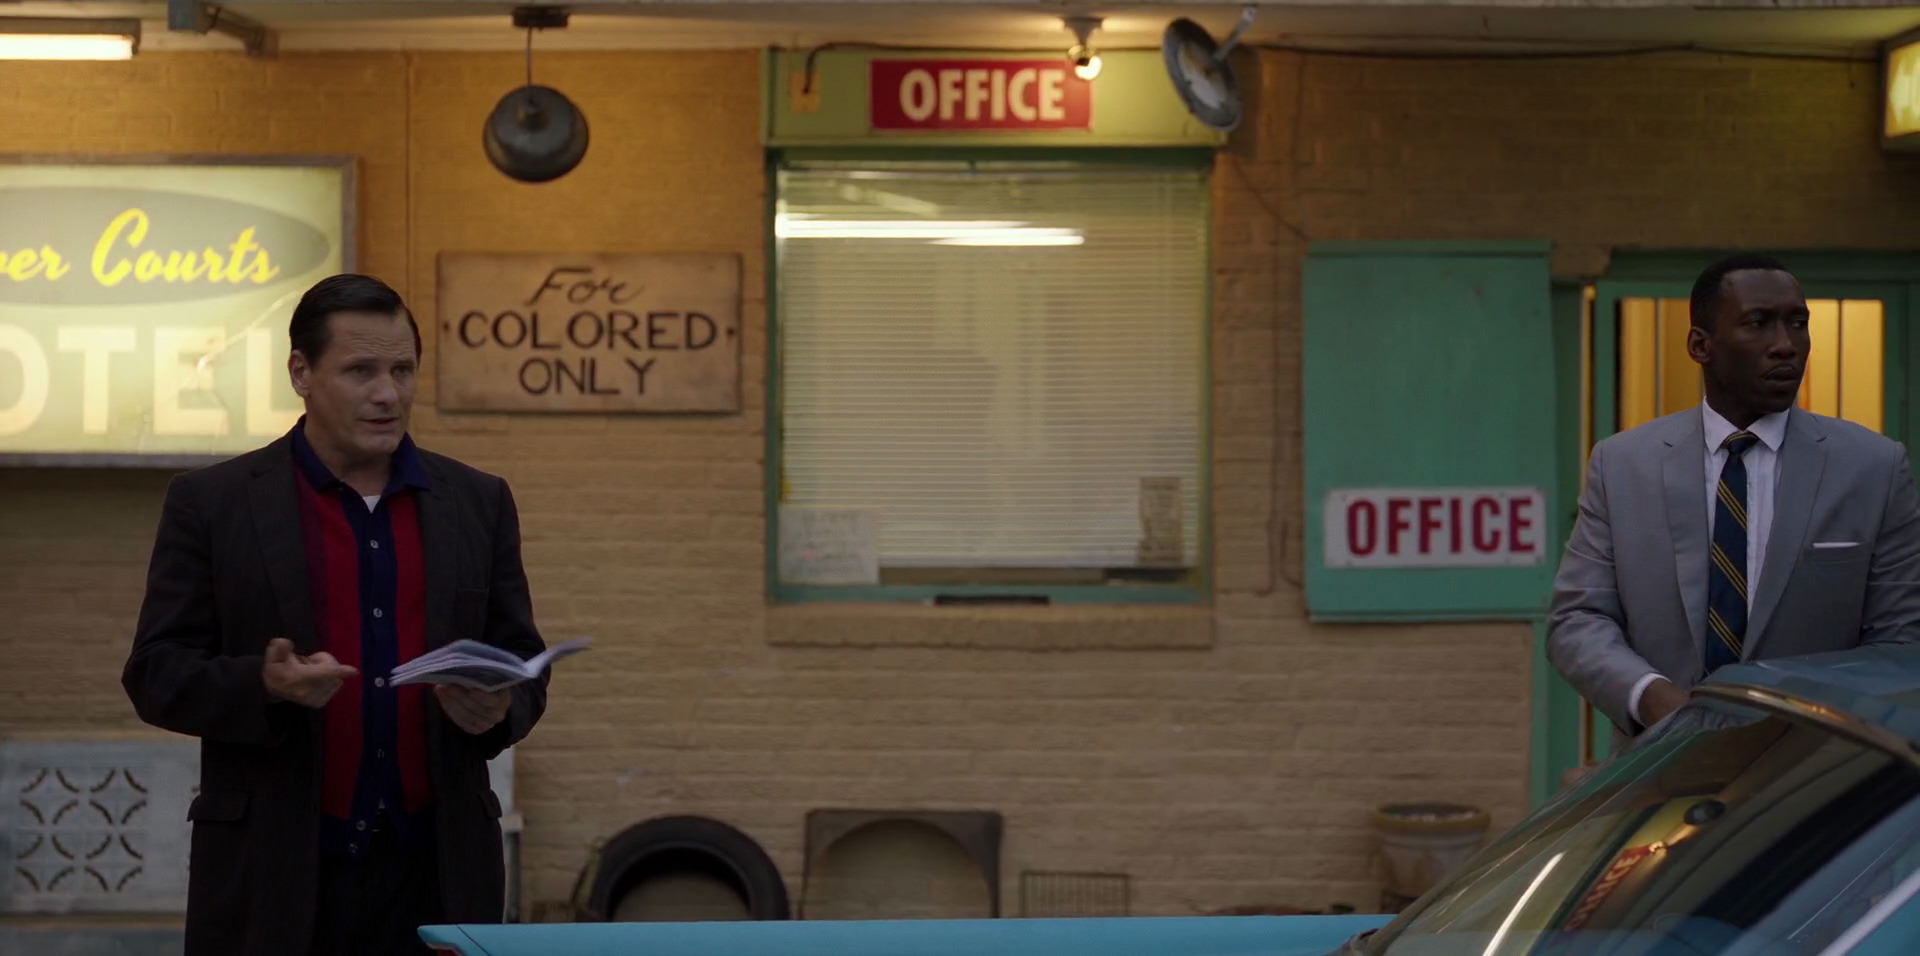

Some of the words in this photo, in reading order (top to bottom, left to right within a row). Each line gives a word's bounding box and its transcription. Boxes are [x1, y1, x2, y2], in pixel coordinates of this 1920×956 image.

[900, 68, 1066, 121] OFFICE
[91, 208, 280, 286] Courts
[523, 266, 644, 306] For
[458, 310, 718, 350] COLORED
[518, 356, 656, 395] ONLY
[1346, 496, 1536, 556] OFFICE
